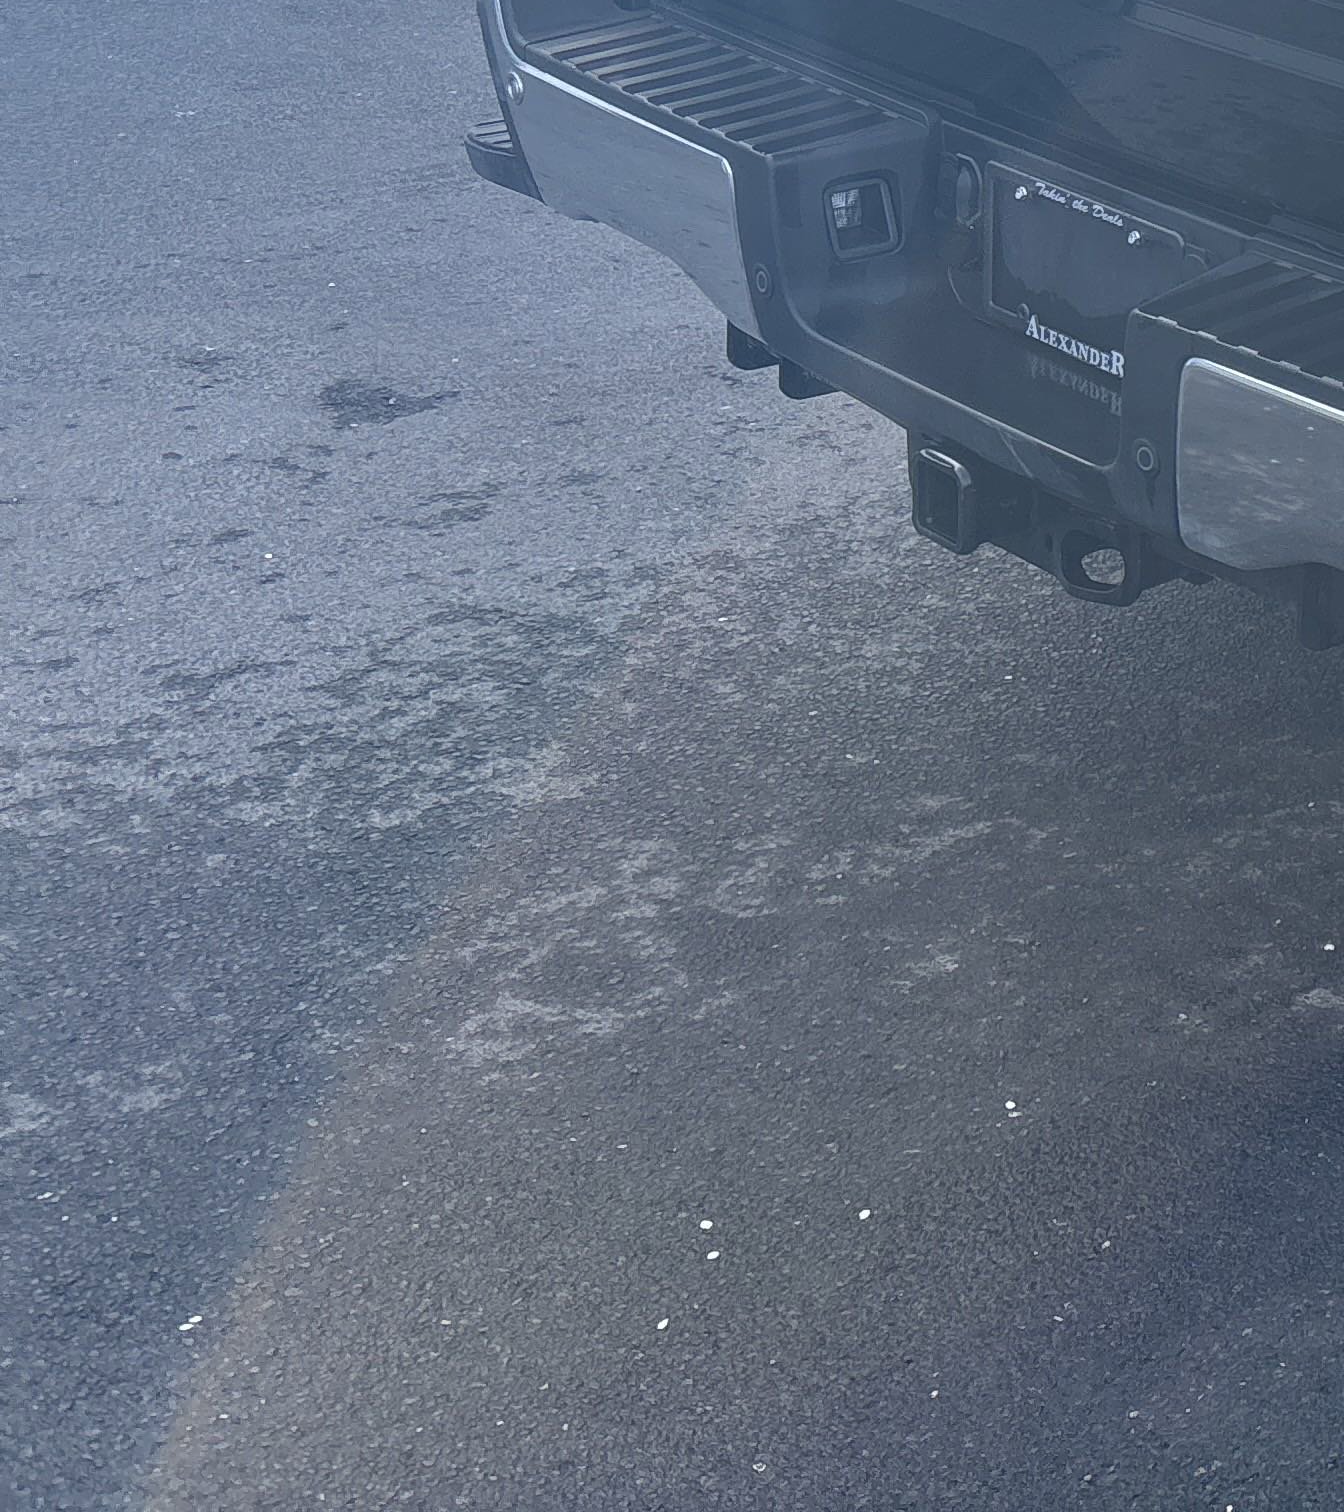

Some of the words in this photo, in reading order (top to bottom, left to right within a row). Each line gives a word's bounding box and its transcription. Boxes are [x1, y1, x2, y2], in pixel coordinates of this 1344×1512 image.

[1034, 181, 1071, 205] Takin'
[1072, 198, 1090, 214] the
[1092, 204, 1124, 227] Deals
[1025, 313, 1126, 378] ALEXANDER
